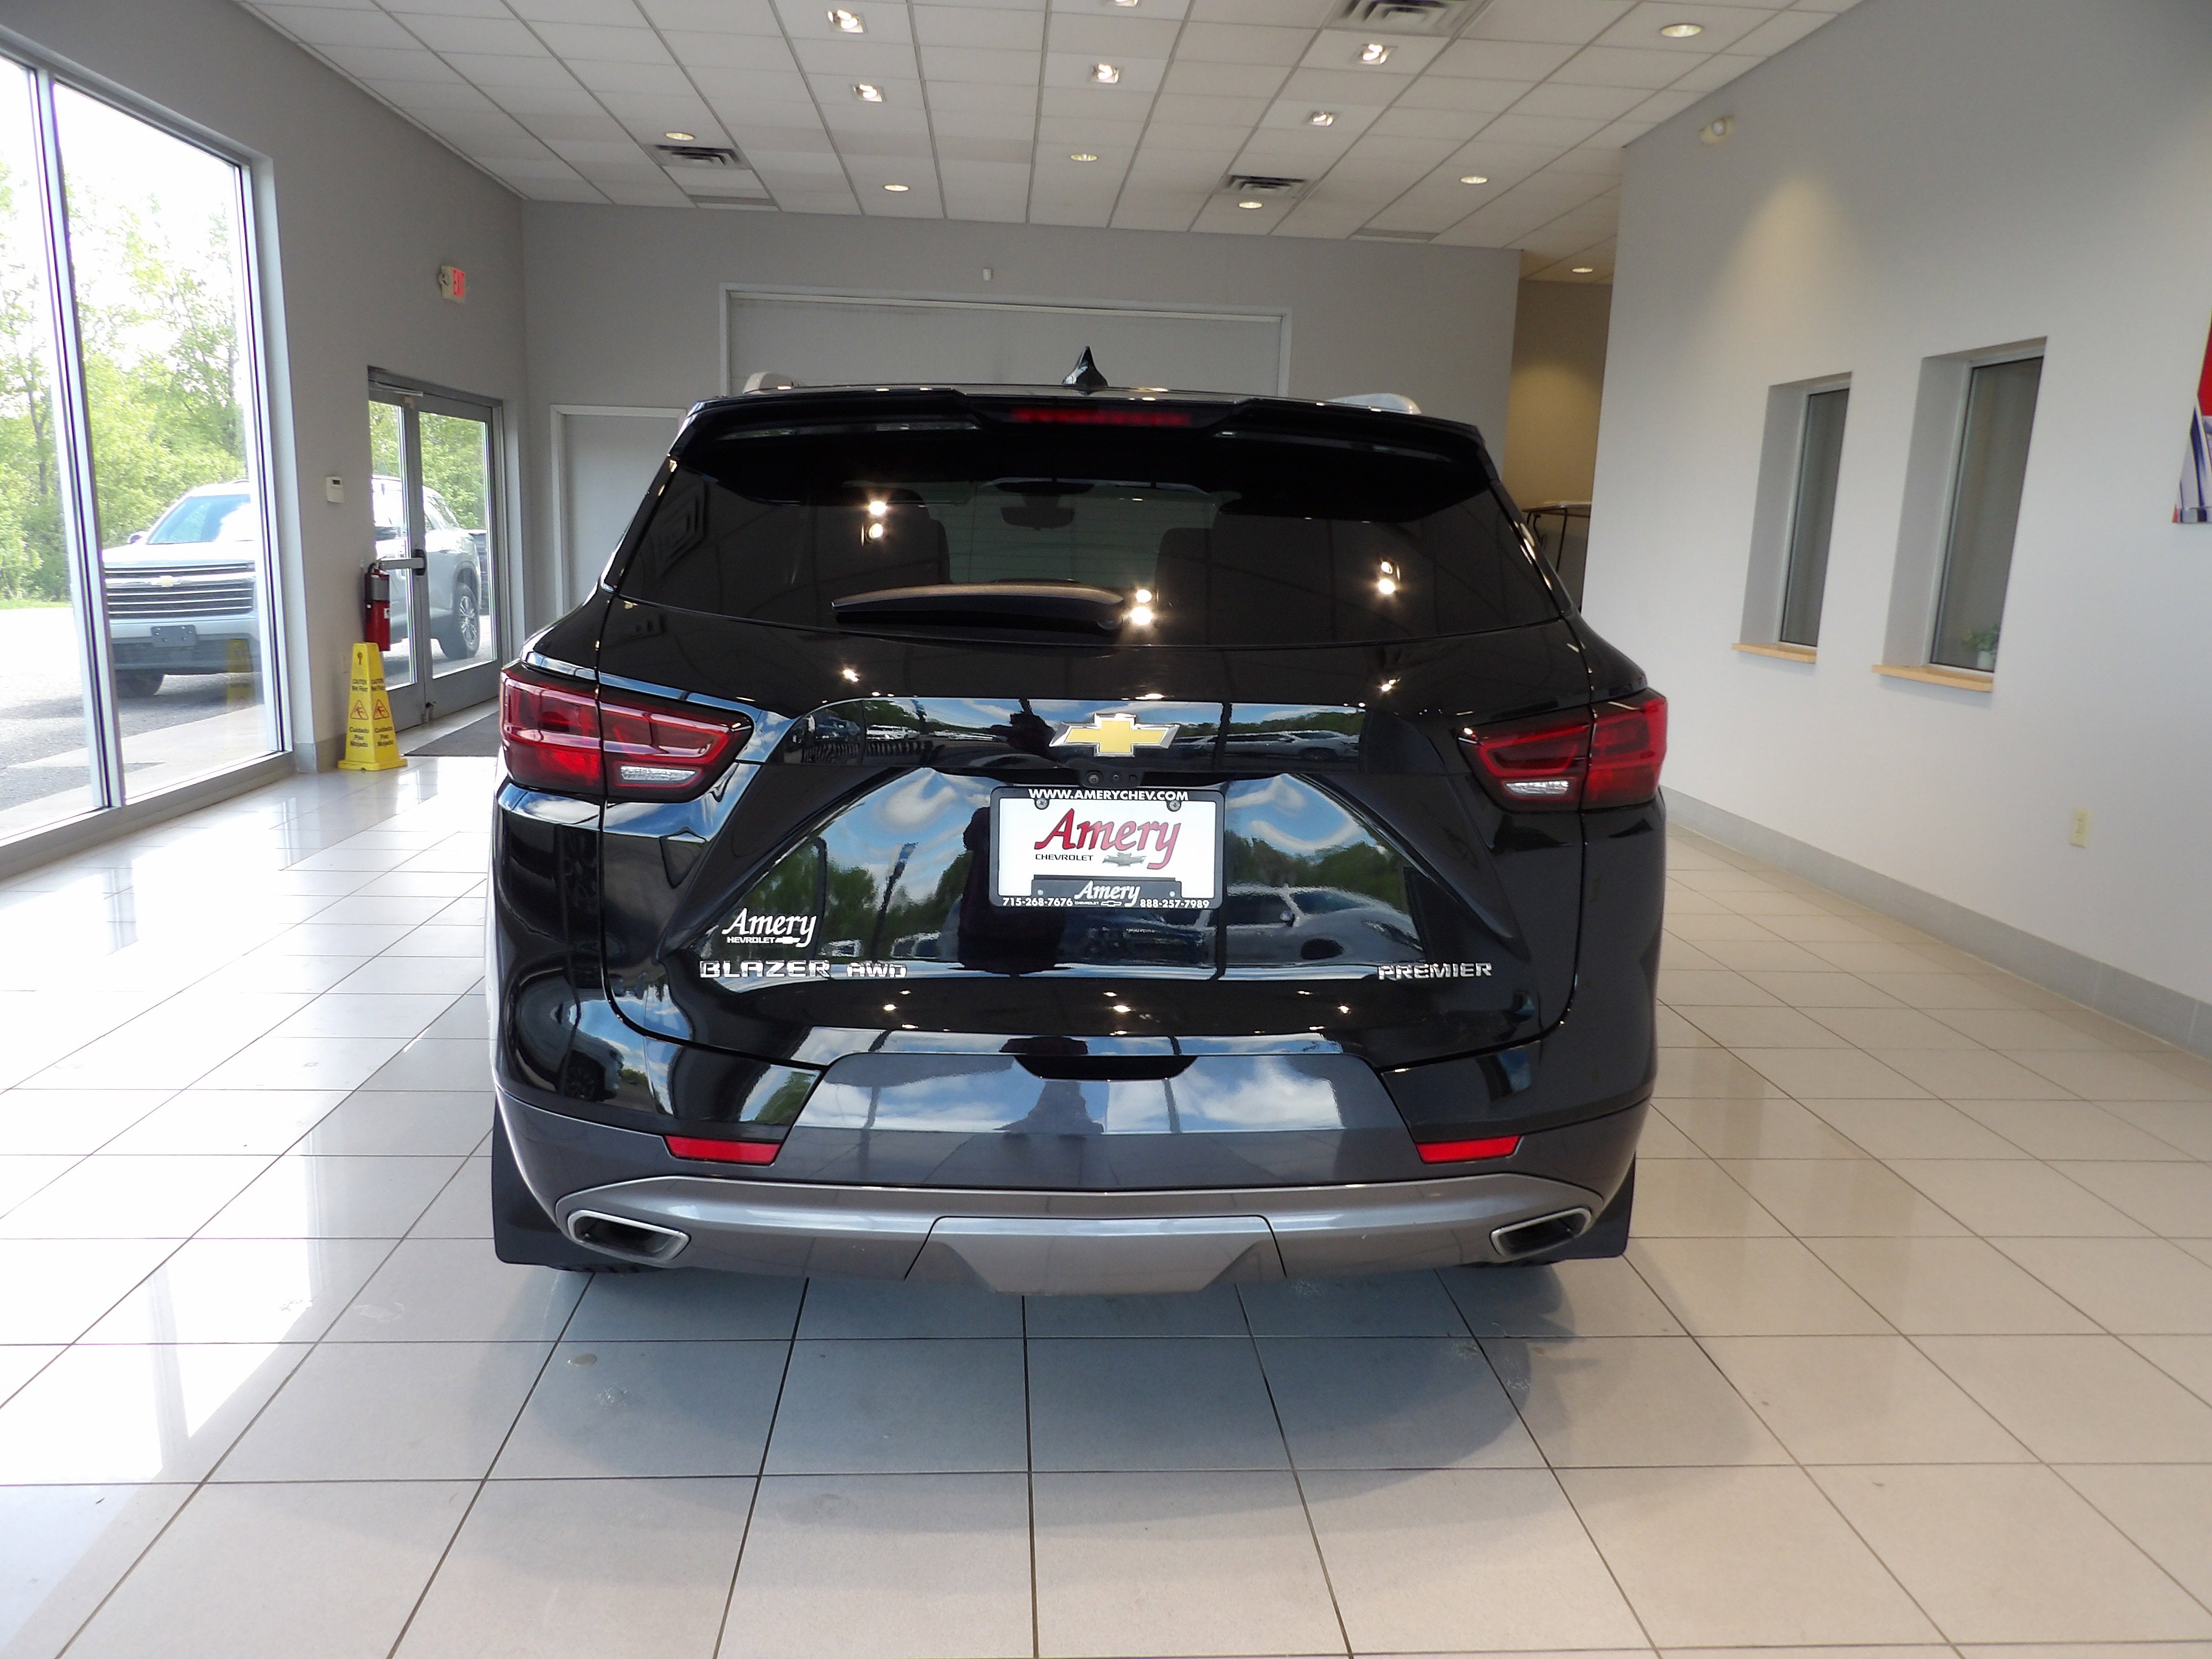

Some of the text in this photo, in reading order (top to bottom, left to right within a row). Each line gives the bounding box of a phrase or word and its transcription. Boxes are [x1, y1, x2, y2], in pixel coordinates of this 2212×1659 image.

[1028, 789, 1189, 801] WWW.AMERYCHEV.COM
[1034, 807, 1182, 870] Amery
[1002, 897, 1073, 907] 715-268-7676
[1073, 880, 1141, 907] Amery
[1139, 898, 1210, 909] 888-257-7989
[721, 907, 817, 948] Amery
[699, 960, 907, 978] BLAZER AWD
[1377, 962, 1492, 981] PREMIER
